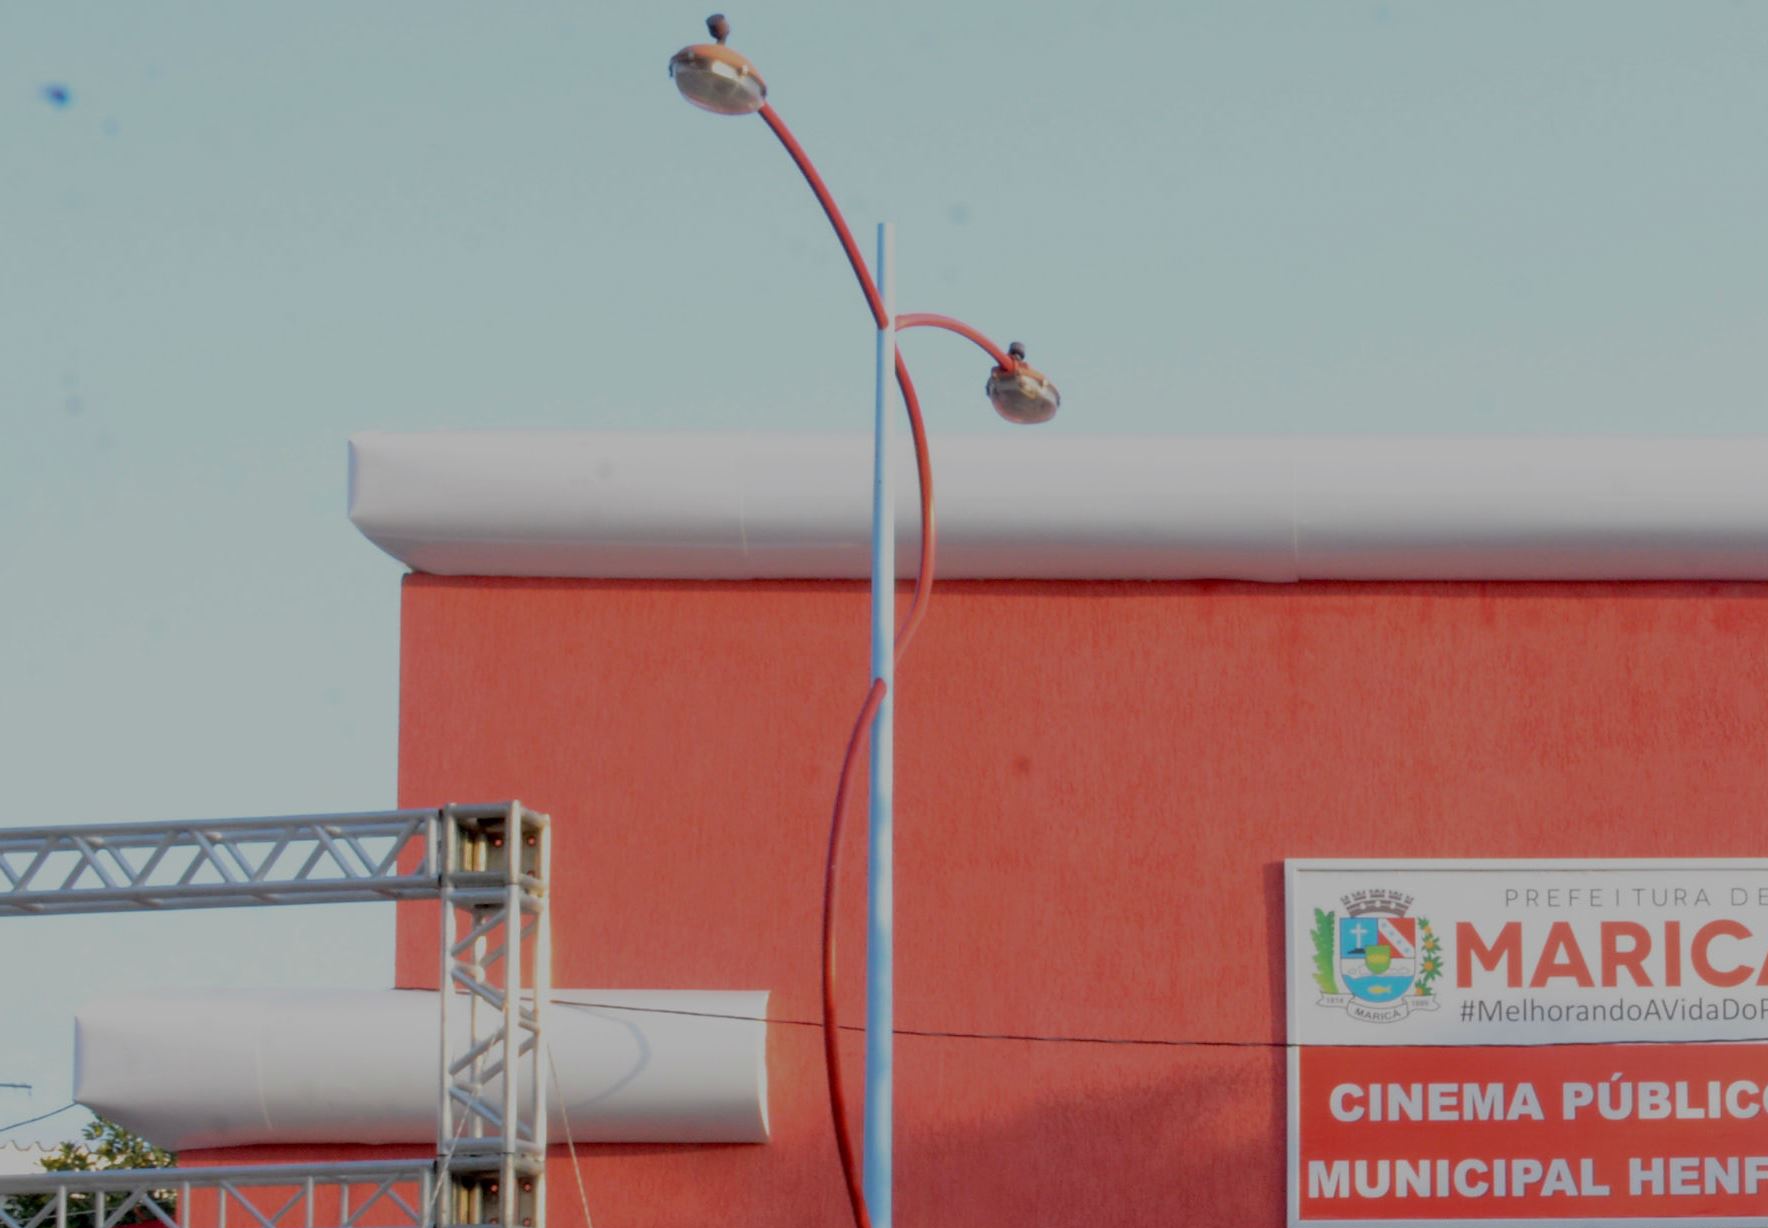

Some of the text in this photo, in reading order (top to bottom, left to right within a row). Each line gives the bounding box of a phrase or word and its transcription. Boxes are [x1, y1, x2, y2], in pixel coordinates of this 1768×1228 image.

[1504, 888, 1712, 907] PREFEITURA
[1329, 1082, 1544, 1122] CINEMA
[1308, 1158, 1610, 1199] MUNICIPAL
